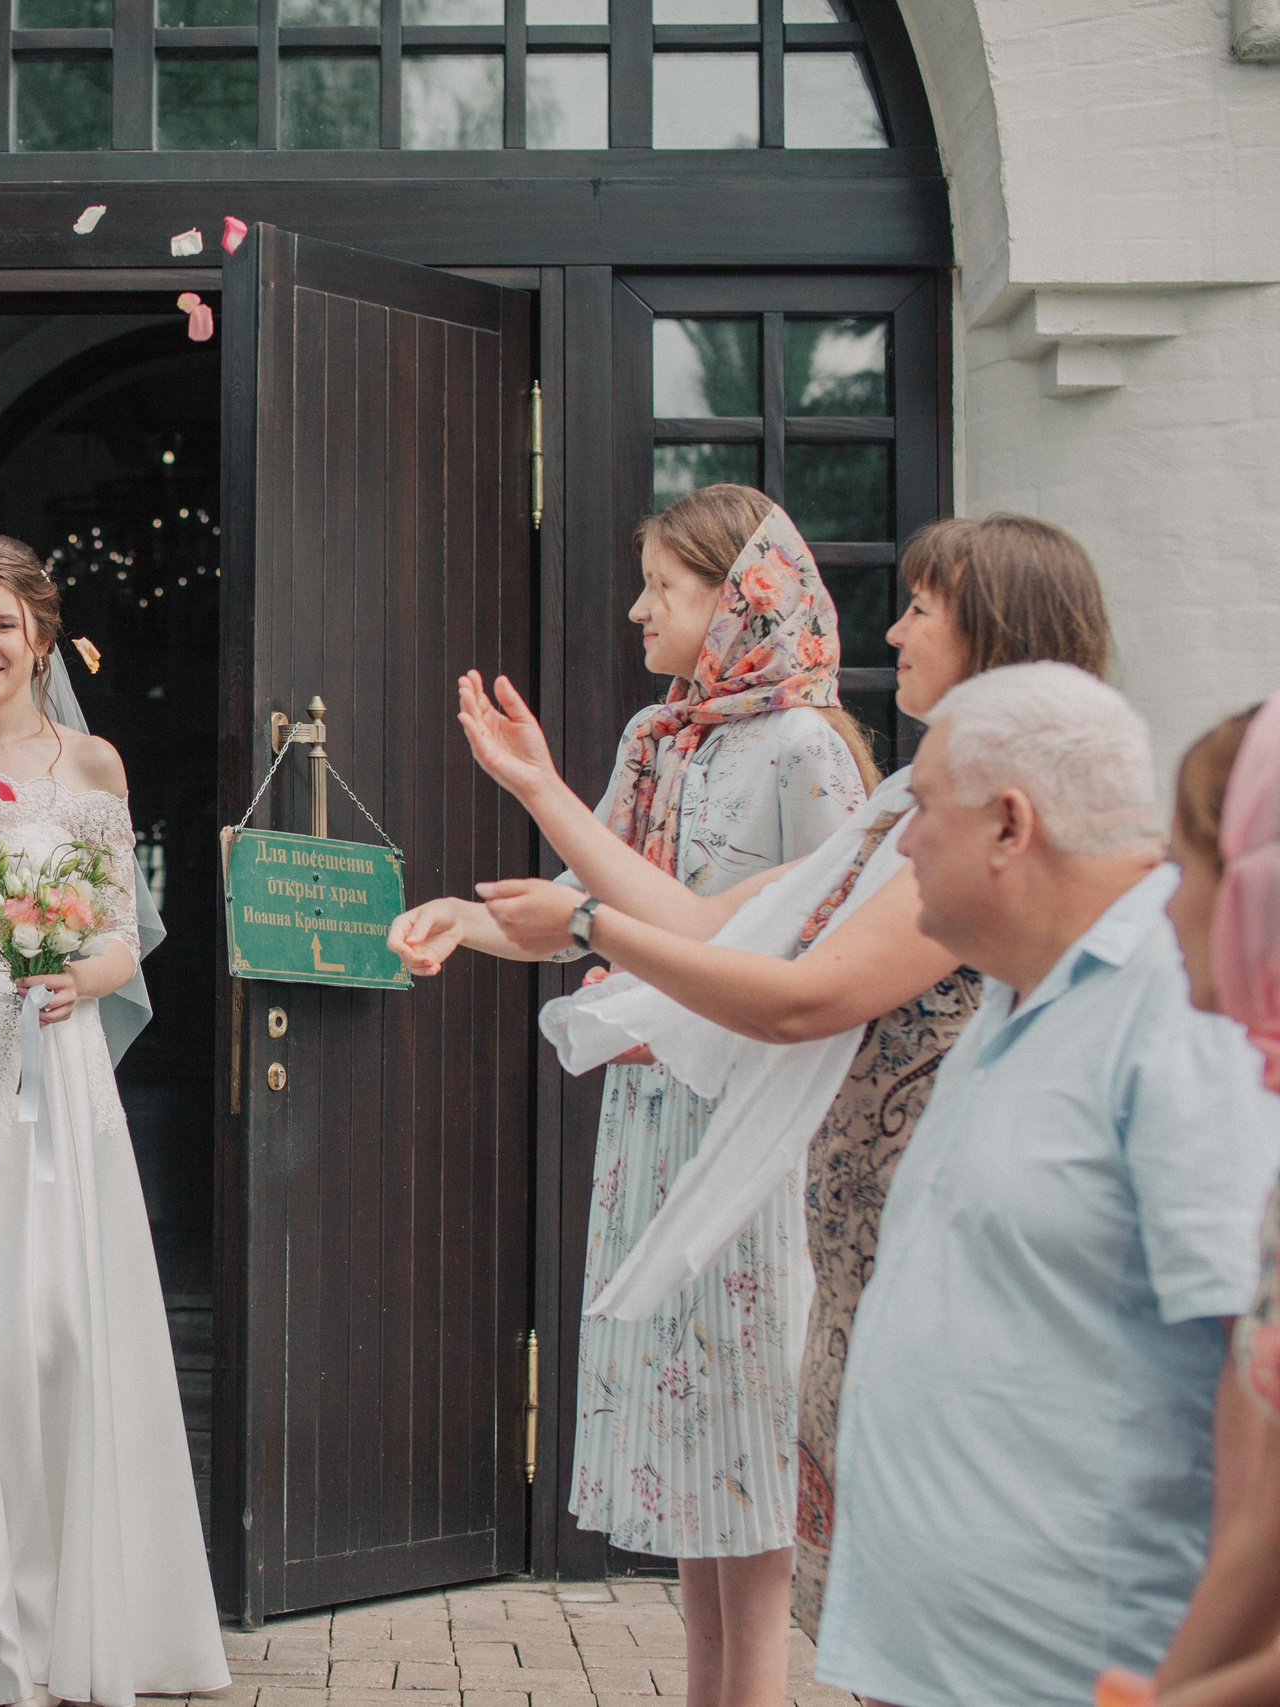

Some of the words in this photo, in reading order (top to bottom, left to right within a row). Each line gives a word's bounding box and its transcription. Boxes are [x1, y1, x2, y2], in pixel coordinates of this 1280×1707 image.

[255, 840, 287, 866] Для
[292, 850, 374, 875] посещения
[267, 878, 325, 903] открыт
[330, 886, 368, 908] храм
[243, 905, 292, 927] Иоанна
